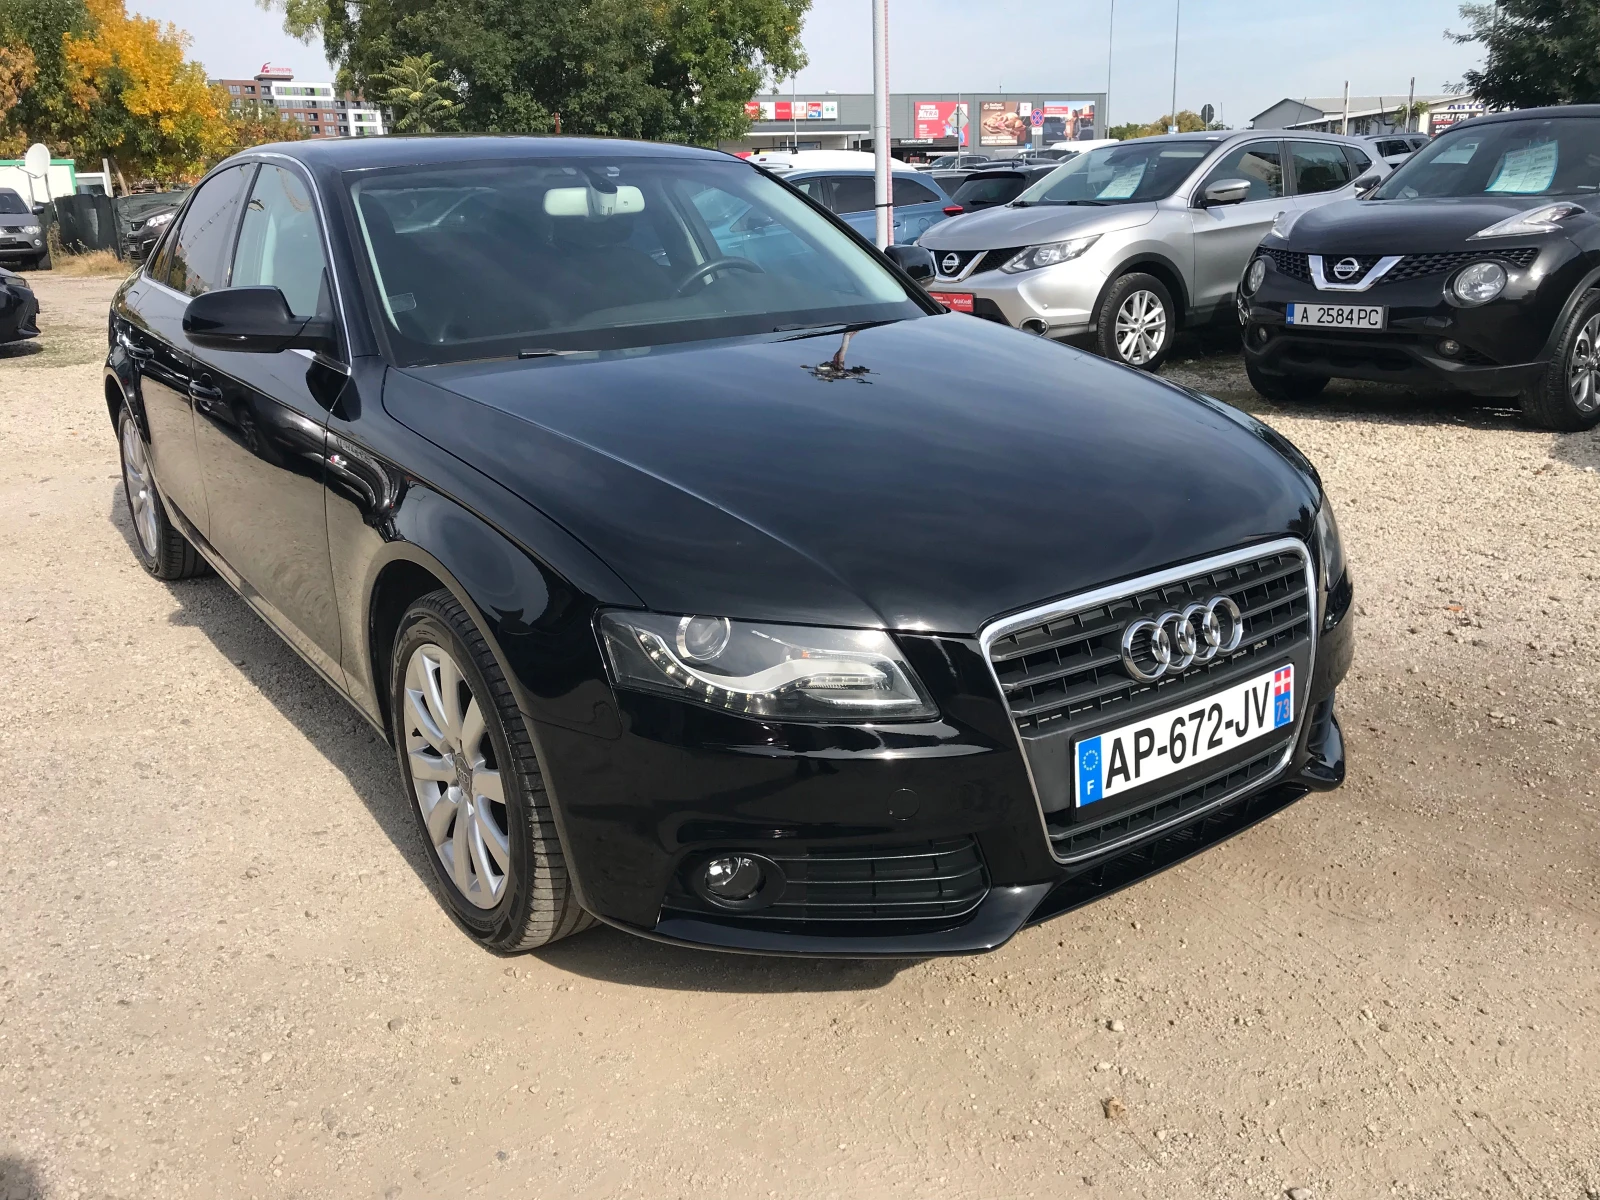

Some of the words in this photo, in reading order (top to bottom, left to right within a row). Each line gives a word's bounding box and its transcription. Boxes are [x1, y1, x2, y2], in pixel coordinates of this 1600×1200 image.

[1300, 306, 1309, 323] A
[1317, 307, 1354, 325] 2584
[1276, 698, 1290, 722] 73
[1105, 681, 1271, 790] AP-672-JV
[1086, 779, 1095, 796] F
